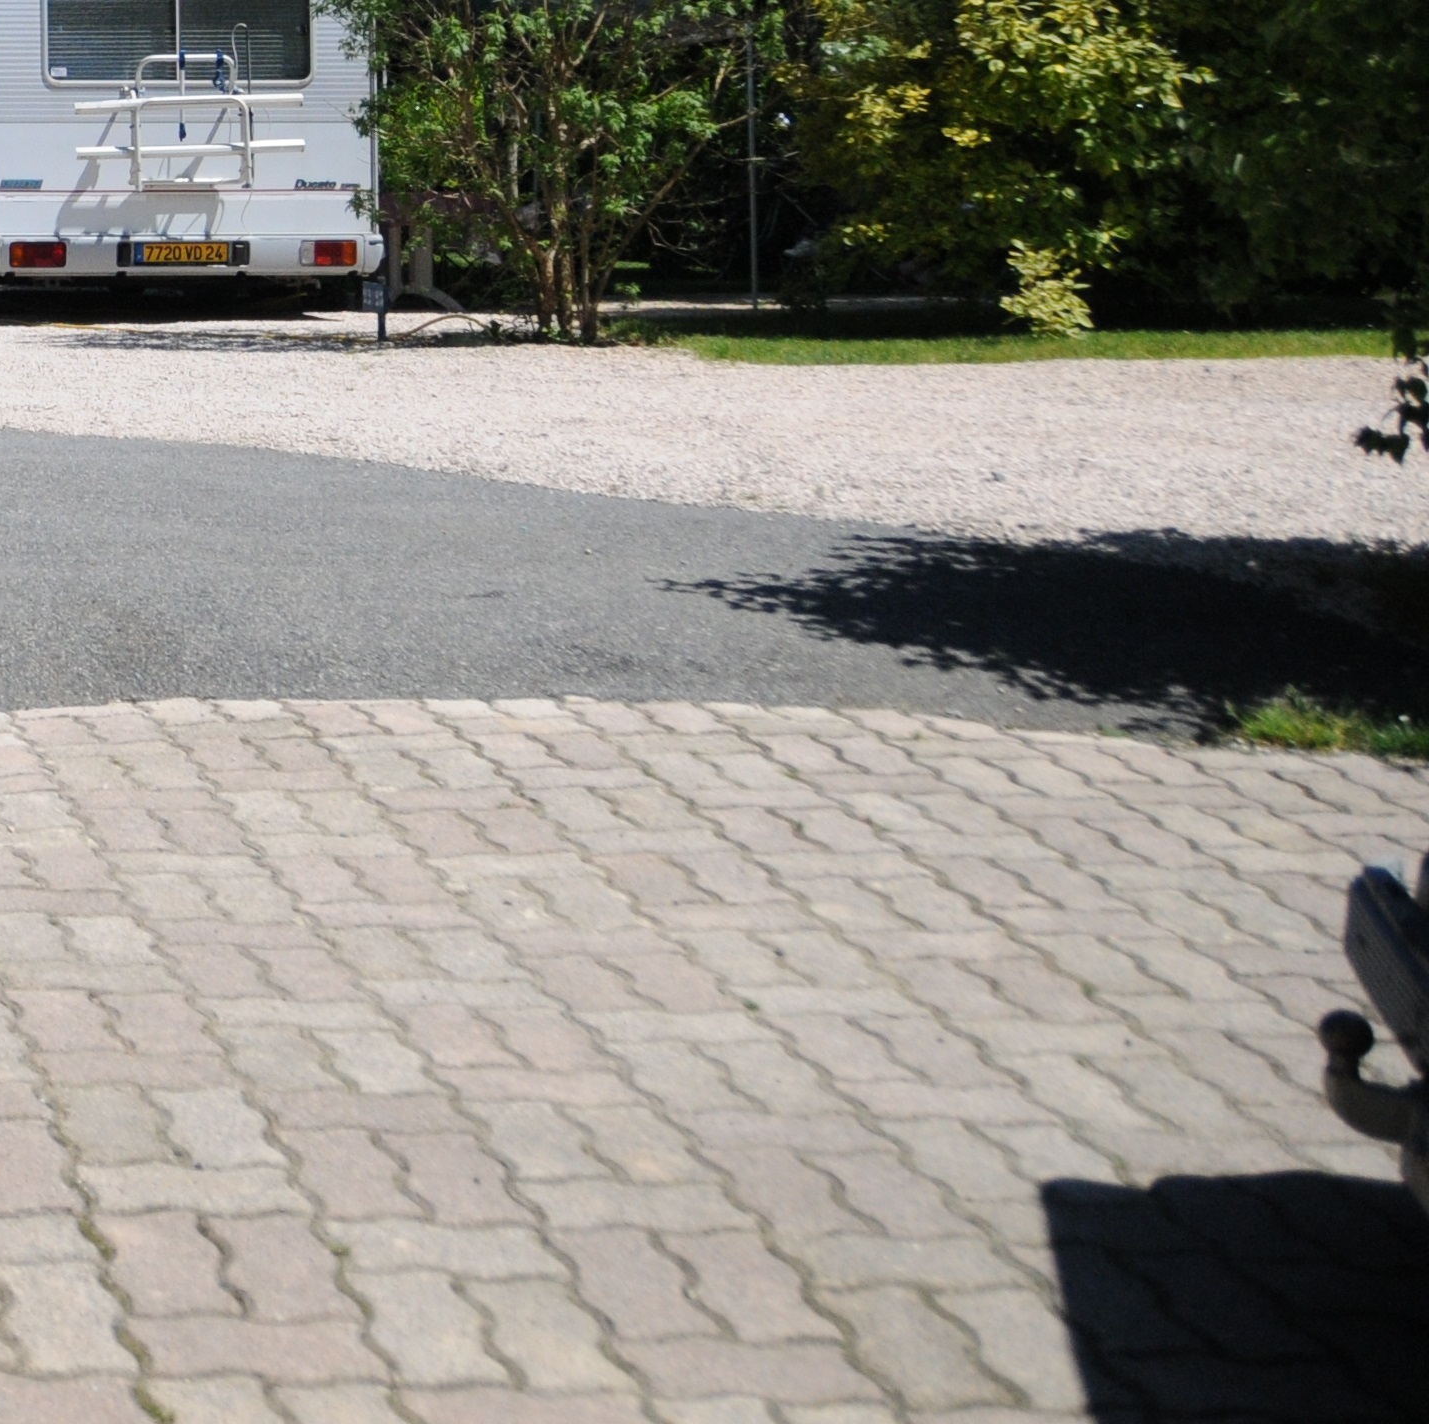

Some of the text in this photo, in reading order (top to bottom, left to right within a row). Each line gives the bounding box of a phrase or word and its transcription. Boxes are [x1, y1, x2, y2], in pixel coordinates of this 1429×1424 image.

[145, 245, 224, 261] 7720 VD 24
